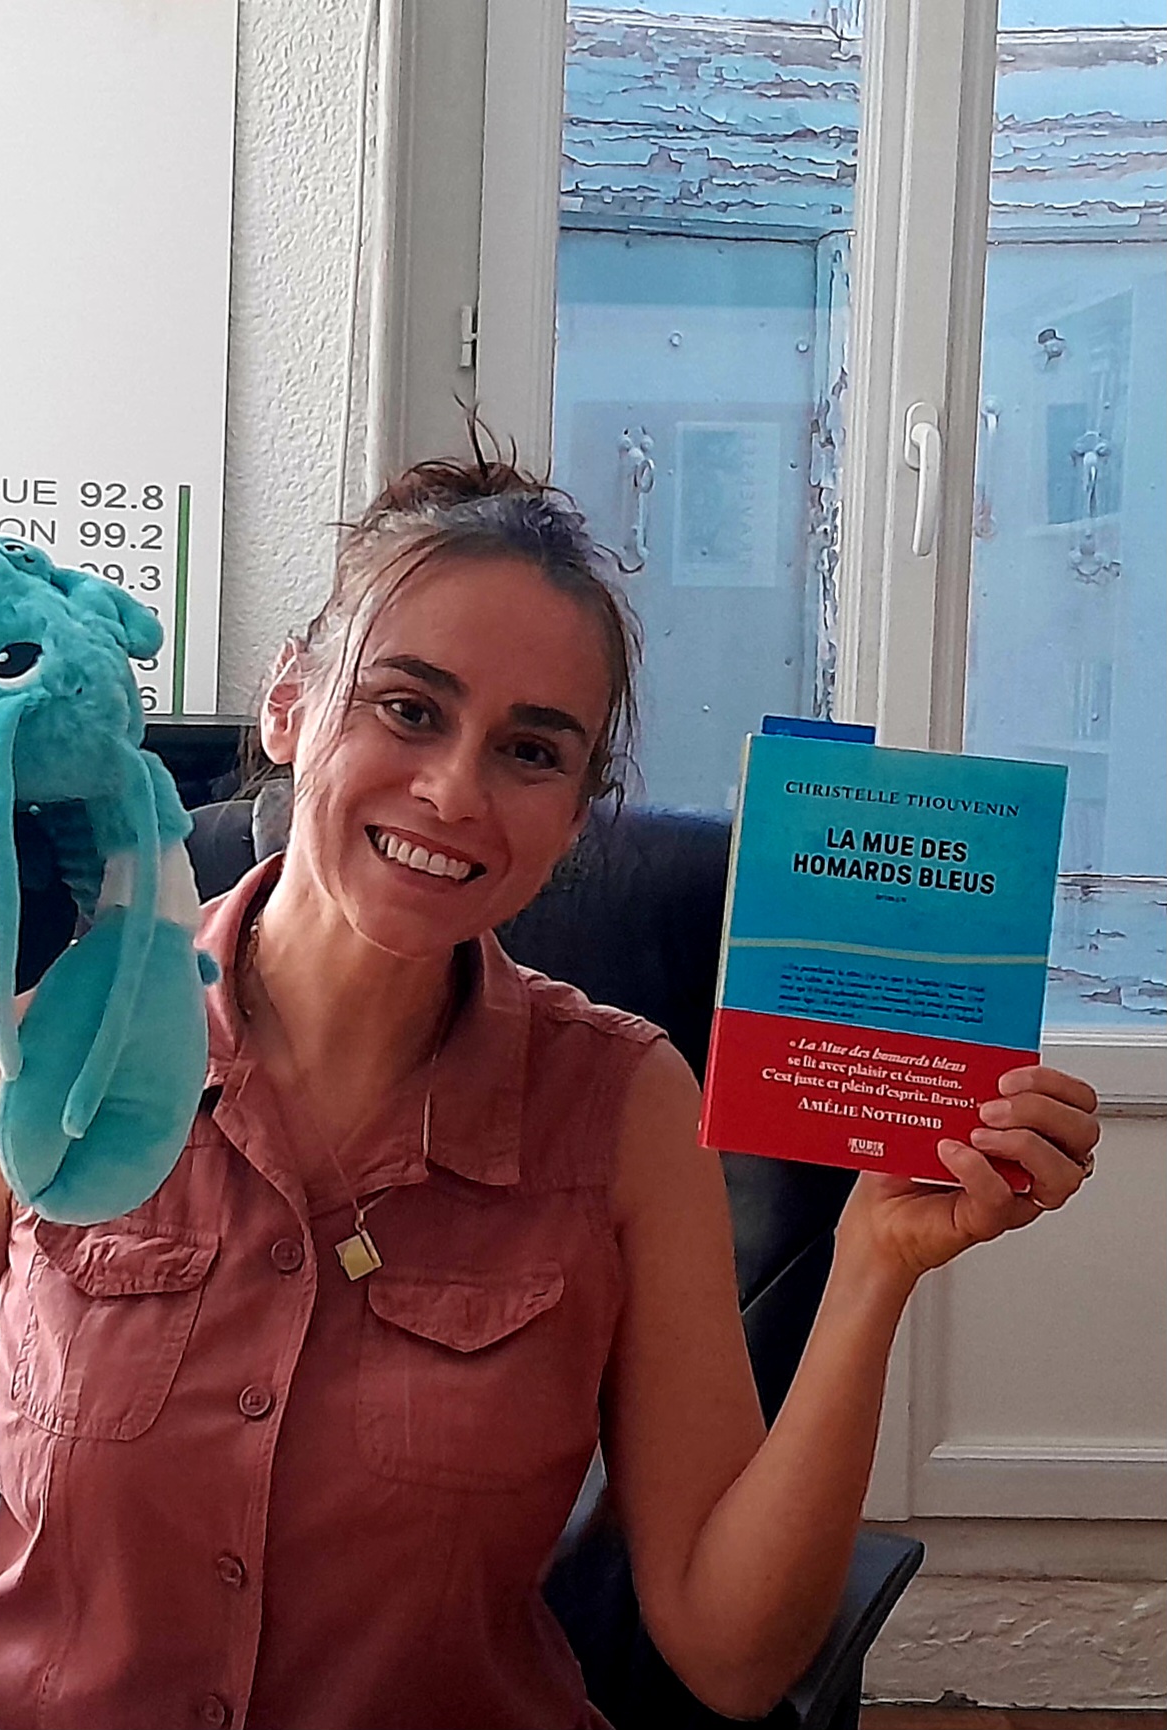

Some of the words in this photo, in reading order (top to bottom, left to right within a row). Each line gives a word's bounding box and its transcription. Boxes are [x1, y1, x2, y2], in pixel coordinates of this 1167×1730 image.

[80, 482, 164, 511] 92.8
[79, 522, 163, 551] 99.2
[80, 563, 162, 591] 9.3
[785, 781, 900, 805] CHRISTELLE
[907, 793, 1019, 817] THOUVENIN
[826, 827, 855, 850] LA
[862, 831, 915, 857] MUE
[920, 838, 968, 863] DES
[793, 853, 912, 886] HOMARDS
[918, 867, 996, 895] BLEUS
[798, 1038, 816, 1050] La
[817, 1041, 848, 1056] Mue
[787, 1057, 801, 1066] se
[848, 1063, 888, 1079] plaisir
[890, 1071, 902, 1081] et
[794, 1072, 825, 1087] juste
[841, 1079, 874, 1094] plein
